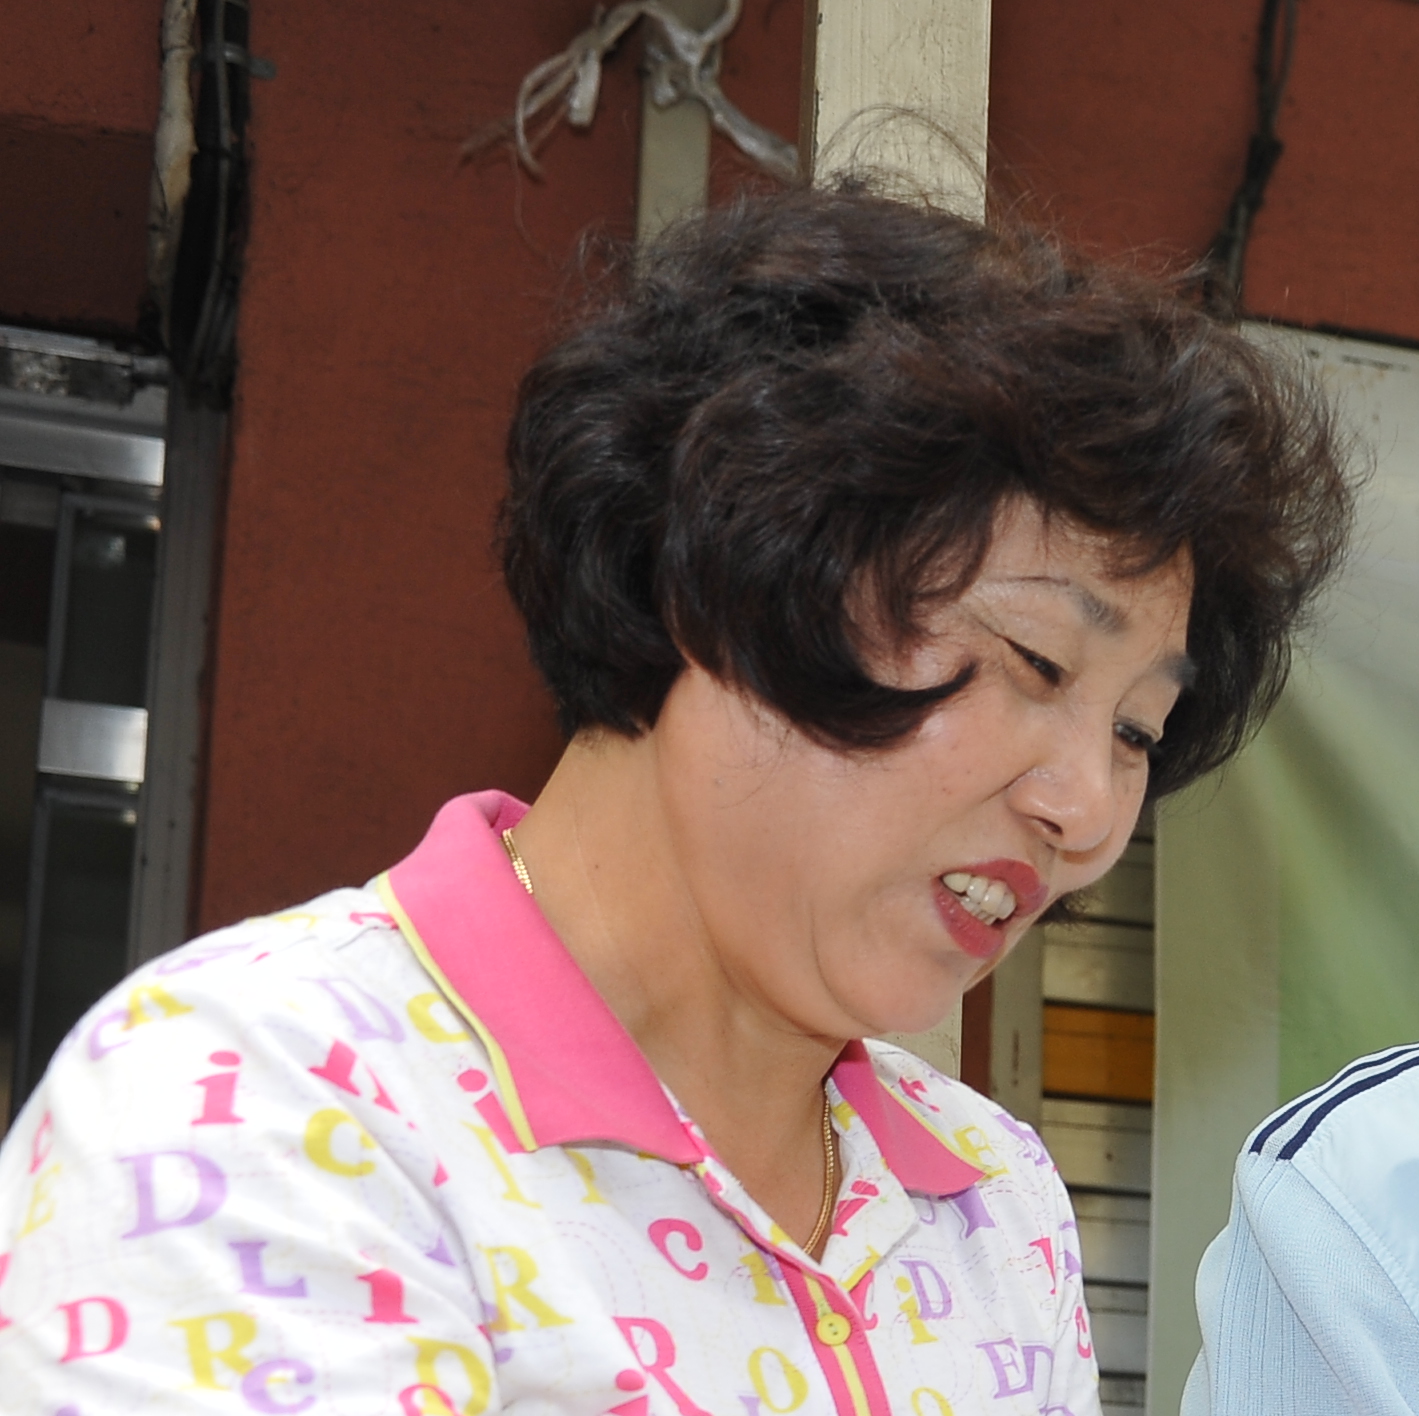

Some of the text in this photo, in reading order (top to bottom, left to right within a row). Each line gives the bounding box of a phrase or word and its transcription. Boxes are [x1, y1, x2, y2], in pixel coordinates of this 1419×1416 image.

[190, 1050, 246, 1126] i
[116, 1150, 228, 1240] D
[228, 1241, 309, 1298] L
[476, 1244, 574, 1331] R
[901, 1260, 952, 1319] D
[56, 1297, 130, 1363] D
[894, 1277, 937, 1344] i
[168, 1311, 262, 1390] R
[747, 1346, 808, 1413] O
